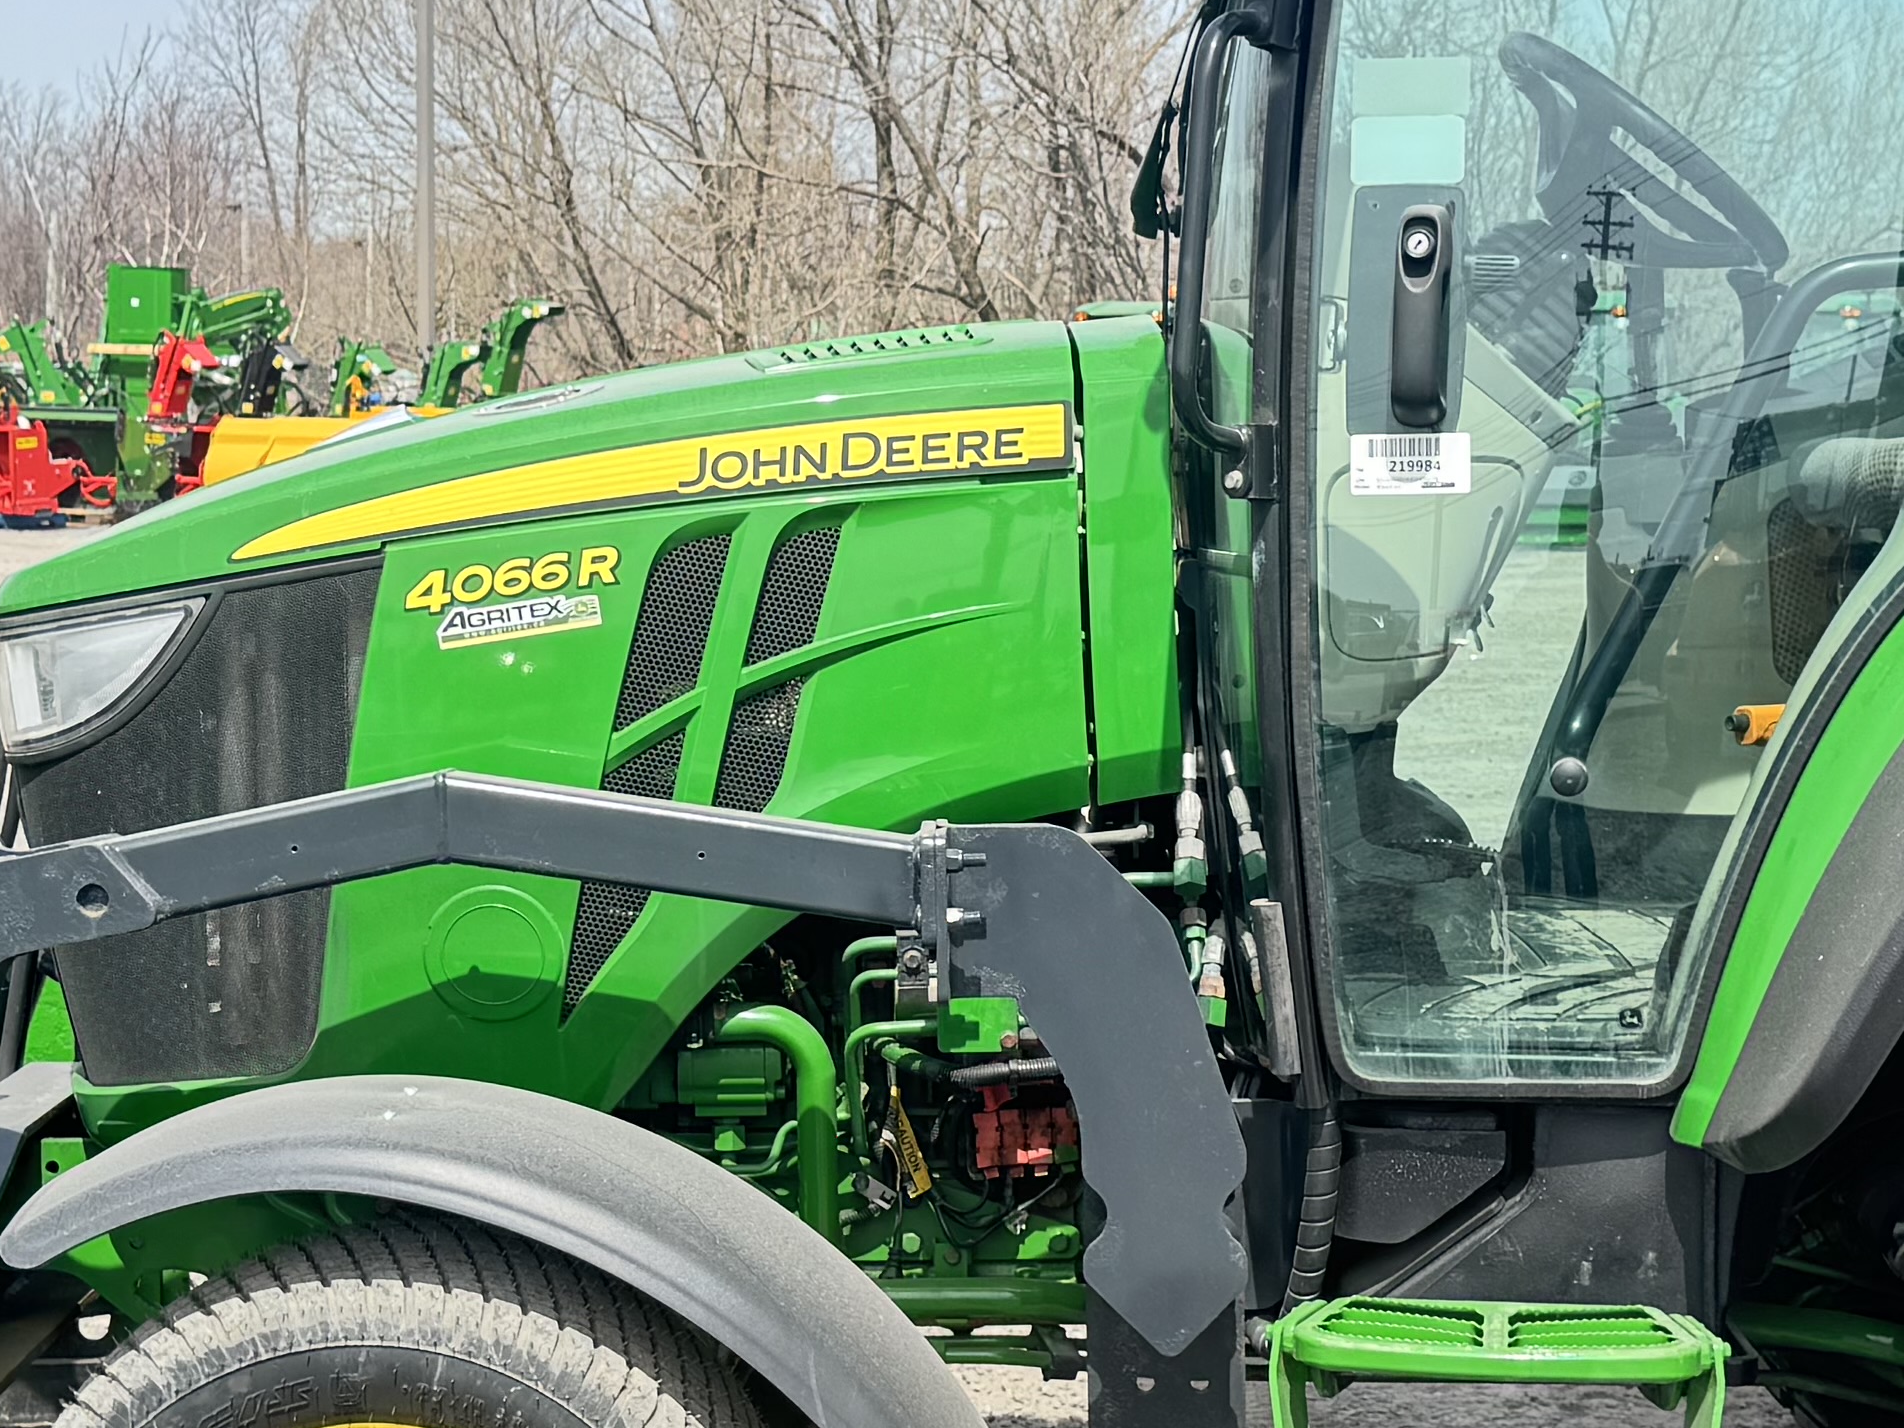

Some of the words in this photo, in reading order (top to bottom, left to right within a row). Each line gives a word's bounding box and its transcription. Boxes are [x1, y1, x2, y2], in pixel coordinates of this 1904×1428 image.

[679, 442, 830, 489] JOHN
[842, 427, 1025, 476] DEERE
[442, 598, 565, 632] AGRITEX
